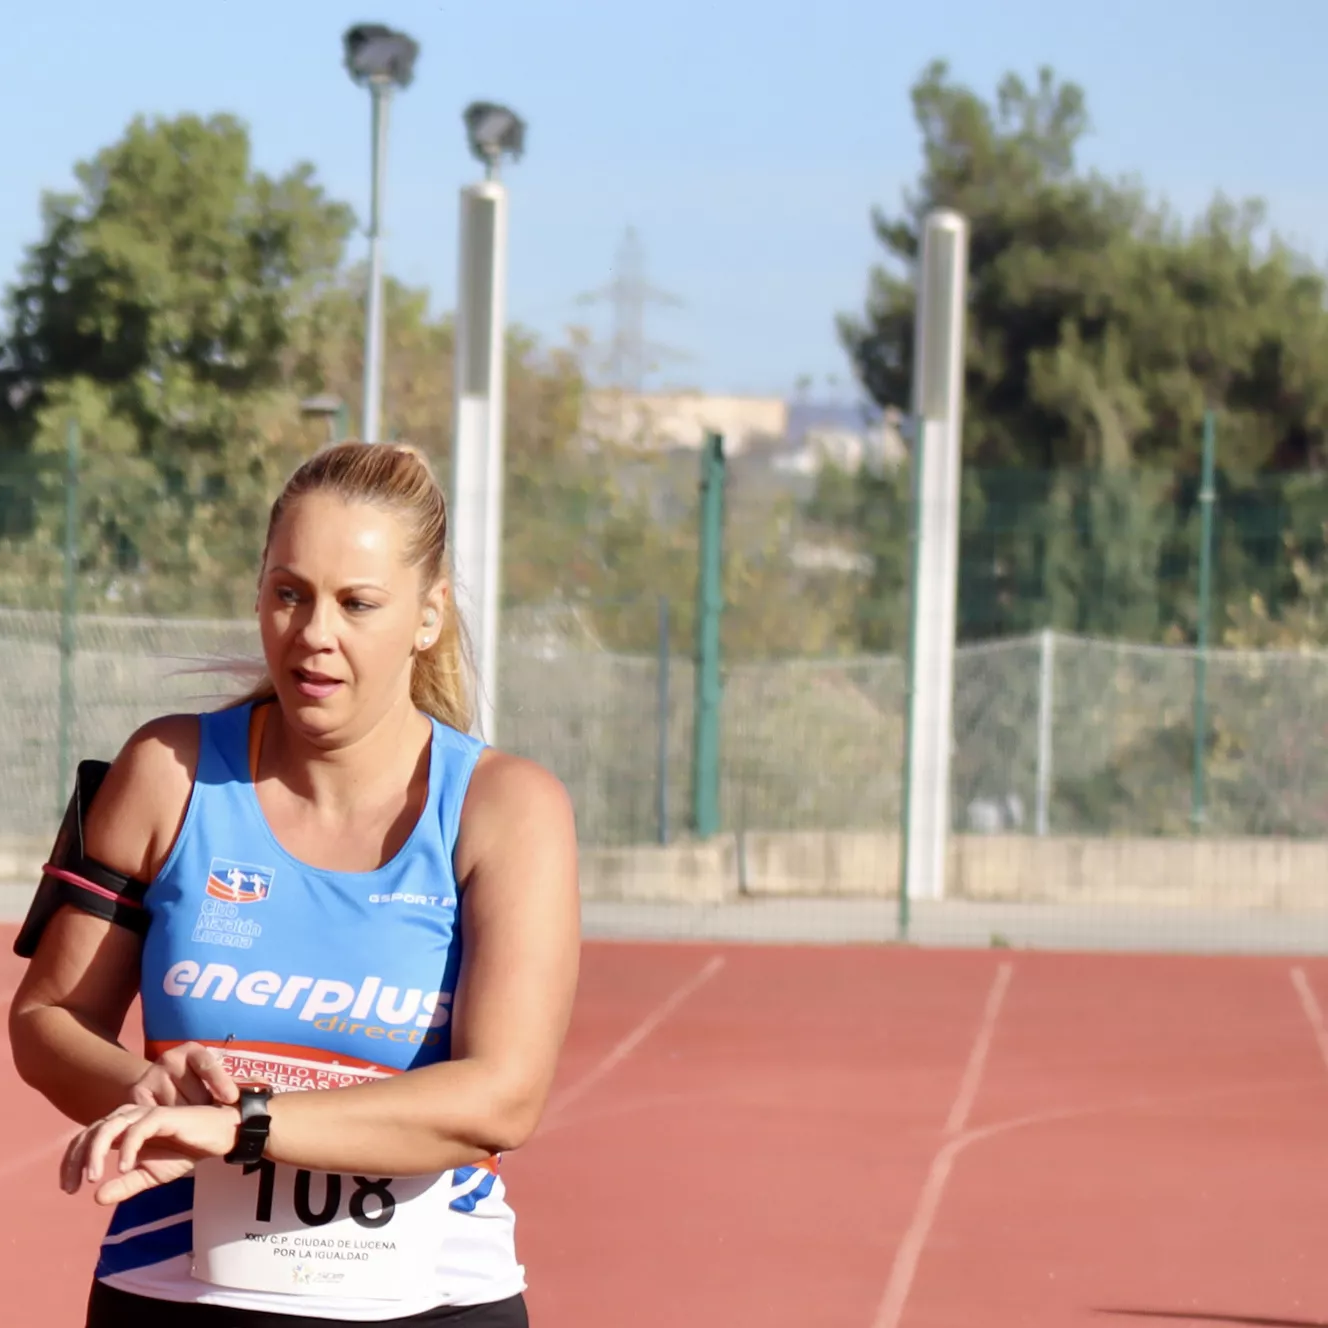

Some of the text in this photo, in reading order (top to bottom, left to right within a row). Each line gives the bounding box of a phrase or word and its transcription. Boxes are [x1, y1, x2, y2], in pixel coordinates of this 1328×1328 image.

[201, 899, 239, 918] Club
[191, 930, 253, 950] Lucena
[162, 960, 452, 1028] enerplus
[313, 1016, 440, 1046] directo
[222, 1055, 310, 1078] CIRCUITO
[243, 1157, 395, 1229] 108
[244, 1232, 268, 1242] XXIV
[294, 1237, 335, 1248] CIUDAD
[337, 1239, 352, 1249] DE
[354, 1240, 397, 1250] LUCENA
[273, 1247, 369, 1261] POR LA IGUALDAD
